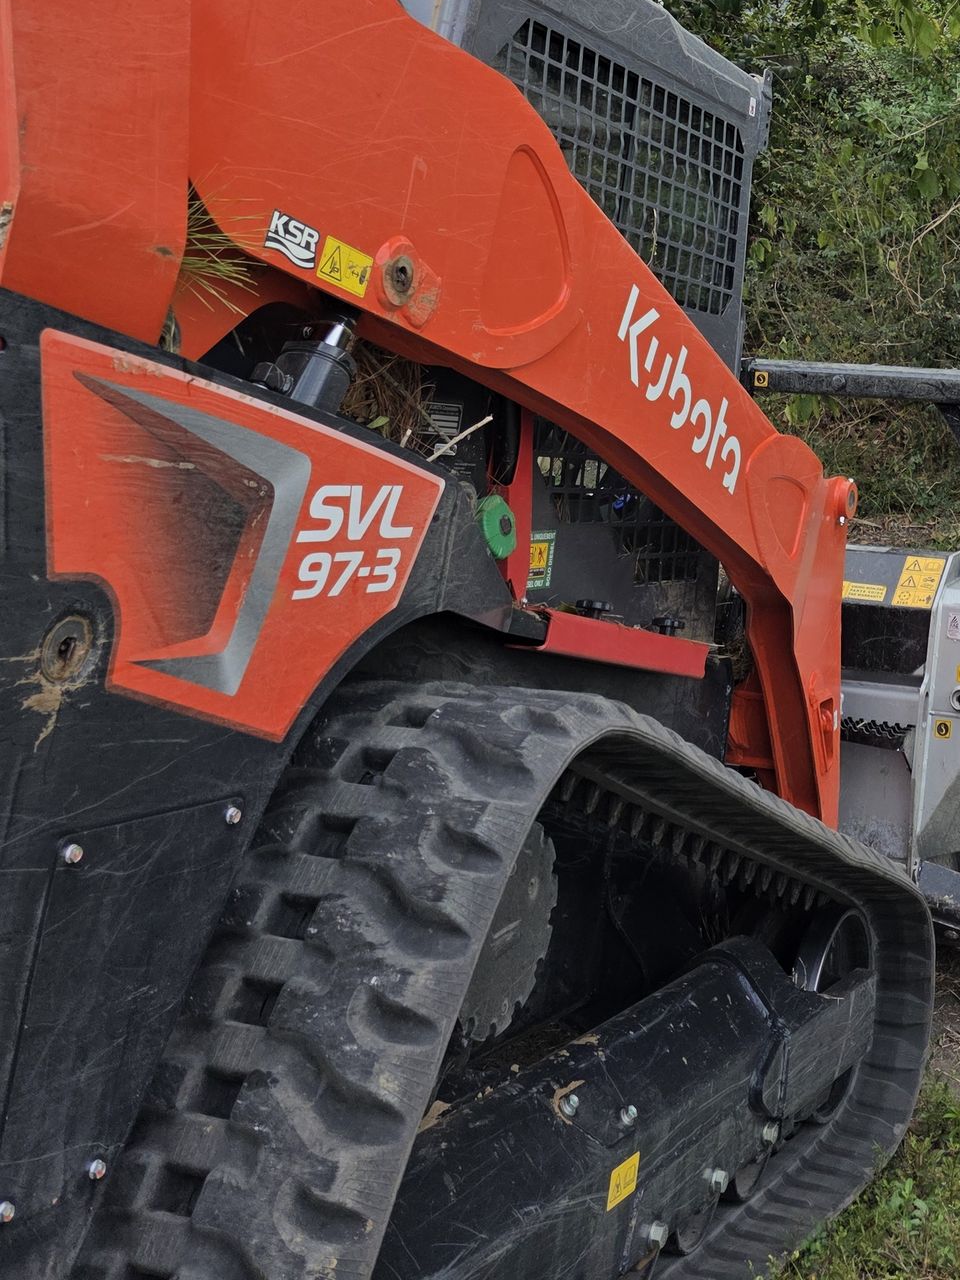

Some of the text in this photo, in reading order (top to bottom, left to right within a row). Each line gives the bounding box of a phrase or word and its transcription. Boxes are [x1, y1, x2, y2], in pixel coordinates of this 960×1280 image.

[270, 210, 319, 252] KSR
[617, 283, 741, 495] Kubota
[296, 485, 413, 543] SVL
[291, 548, 402, 600] 97-3
